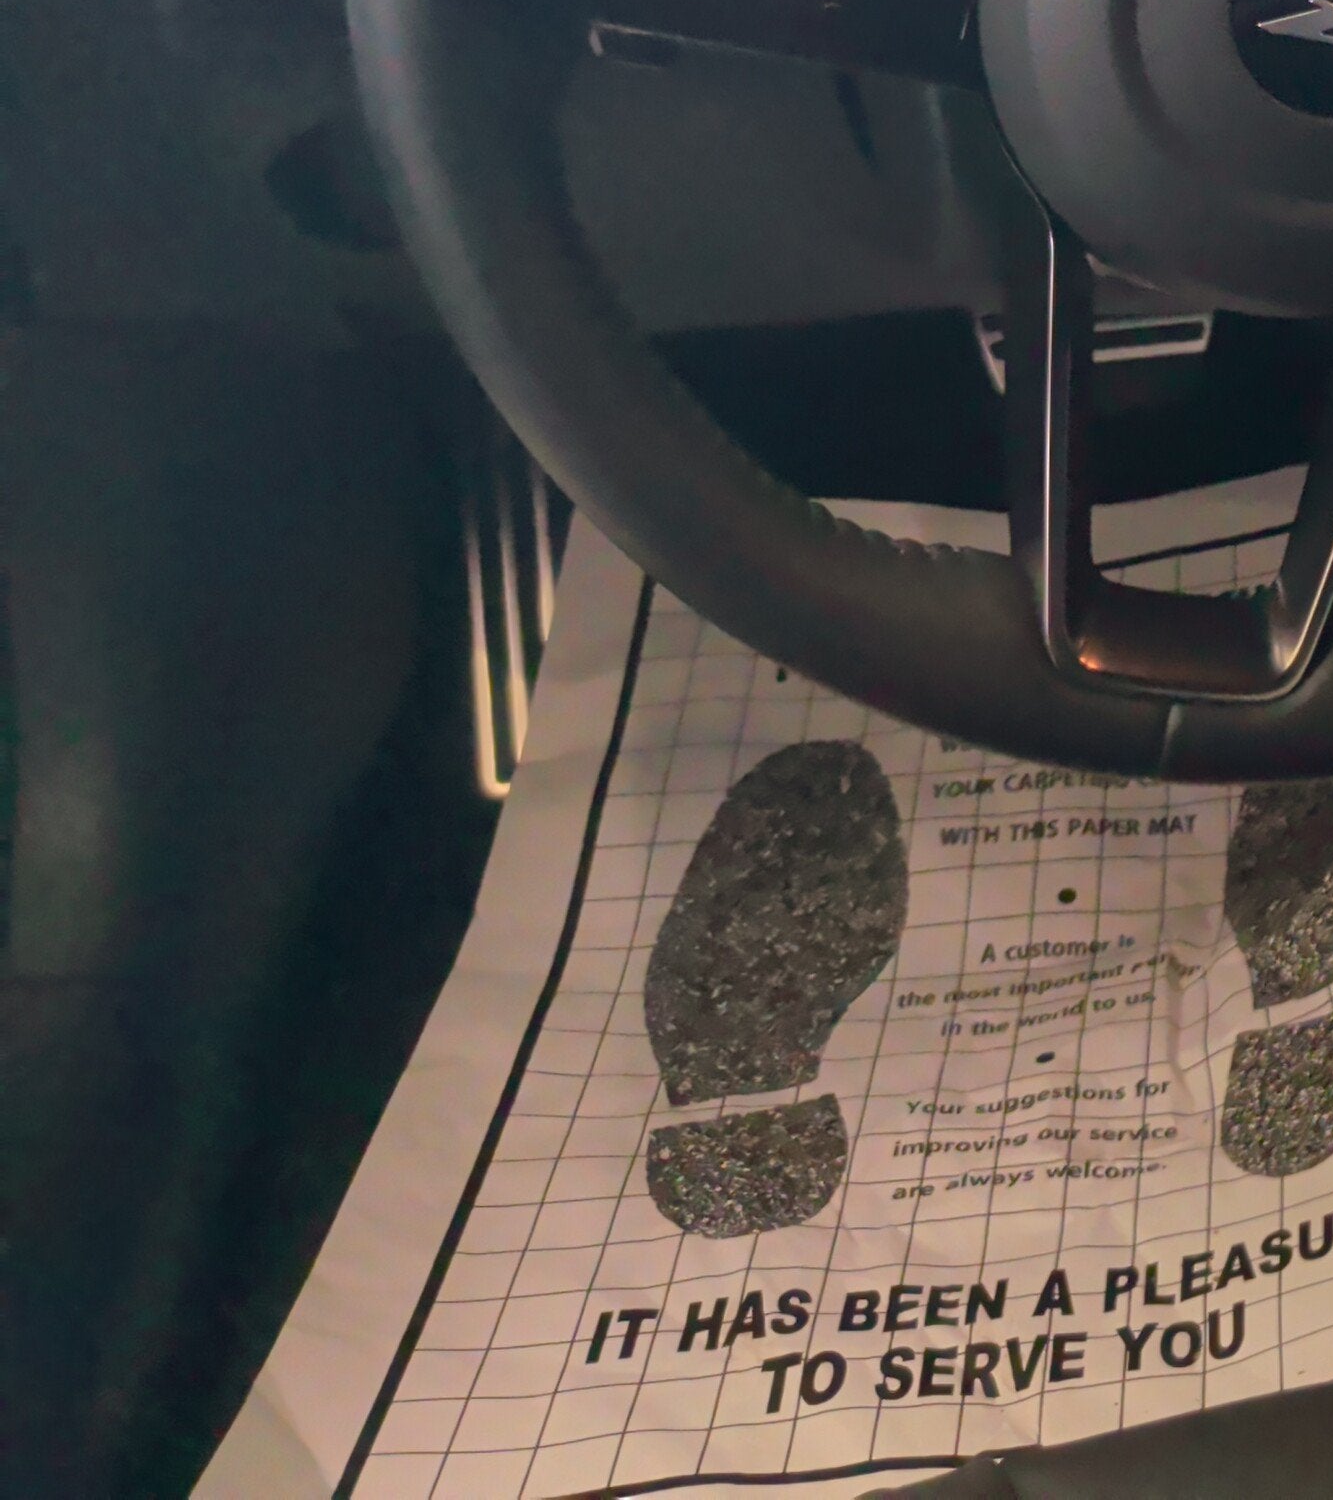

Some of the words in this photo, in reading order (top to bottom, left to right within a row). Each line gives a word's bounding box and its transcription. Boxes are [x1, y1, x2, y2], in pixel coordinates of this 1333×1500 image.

[933, 778, 996, 798] YOUR
[940, 826, 999, 846] WITH
[1010, 819, 1058, 842] THIS
[1068, 818, 1140, 837] PAPER
[1146, 814, 1198, 835] MAT
[981, 943, 996, 963] A
[1004, 940, 1111, 960] customer
[1117, 934, 1136, 948] is
[897, 991, 936, 1009] the
[943, 985, 1000, 1003] most
[1009, 964, 1124, 995] important
[940, 1021, 962, 1037] in
[971, 1020, 1010, 1036] the
[1017, 1000, 1085, 1027] world
[1092, 996, 1117, 1012] to
[905, 1100, 965, 1115] Your
[974, 1083, 1127, 1115] suggestions
[1135, 1078, 1170, 1098] for
[892, 1132, 1028, 1157] improving
[1036, 1126, 1081, 1141] our
[1089, 1124, 1178, 1141] service
[891, 1184, 935, 1200] are
[945, 1169, 1035, 1193] always
[585, 1309, 656, 1364] IT
[677, 1289, 811, 1353] HAS
[838, 1279, 1009, 1333] BEEN
[1032, 1268, 1075, 1317] A
[761, 1352, 847, 1414] TO
[874, 1330, 1088, 1401] SERVE
[1120, 1303, 1246, 1372] YOU
